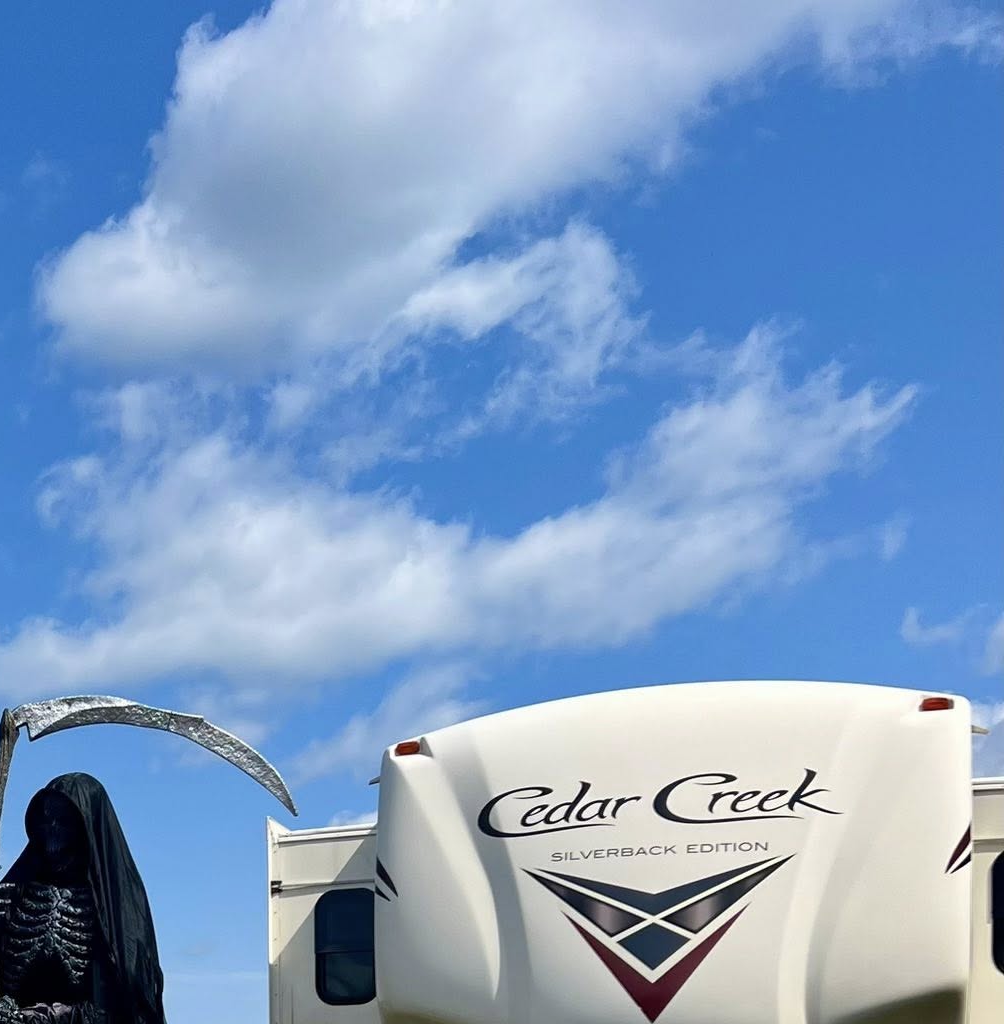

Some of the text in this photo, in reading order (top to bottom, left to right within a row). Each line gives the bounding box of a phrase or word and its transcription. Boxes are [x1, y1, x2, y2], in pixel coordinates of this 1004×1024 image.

[477, 767, 845, 838] Cedar Creek
[550, 841, 770, 863] SILVERBACK EDITION
